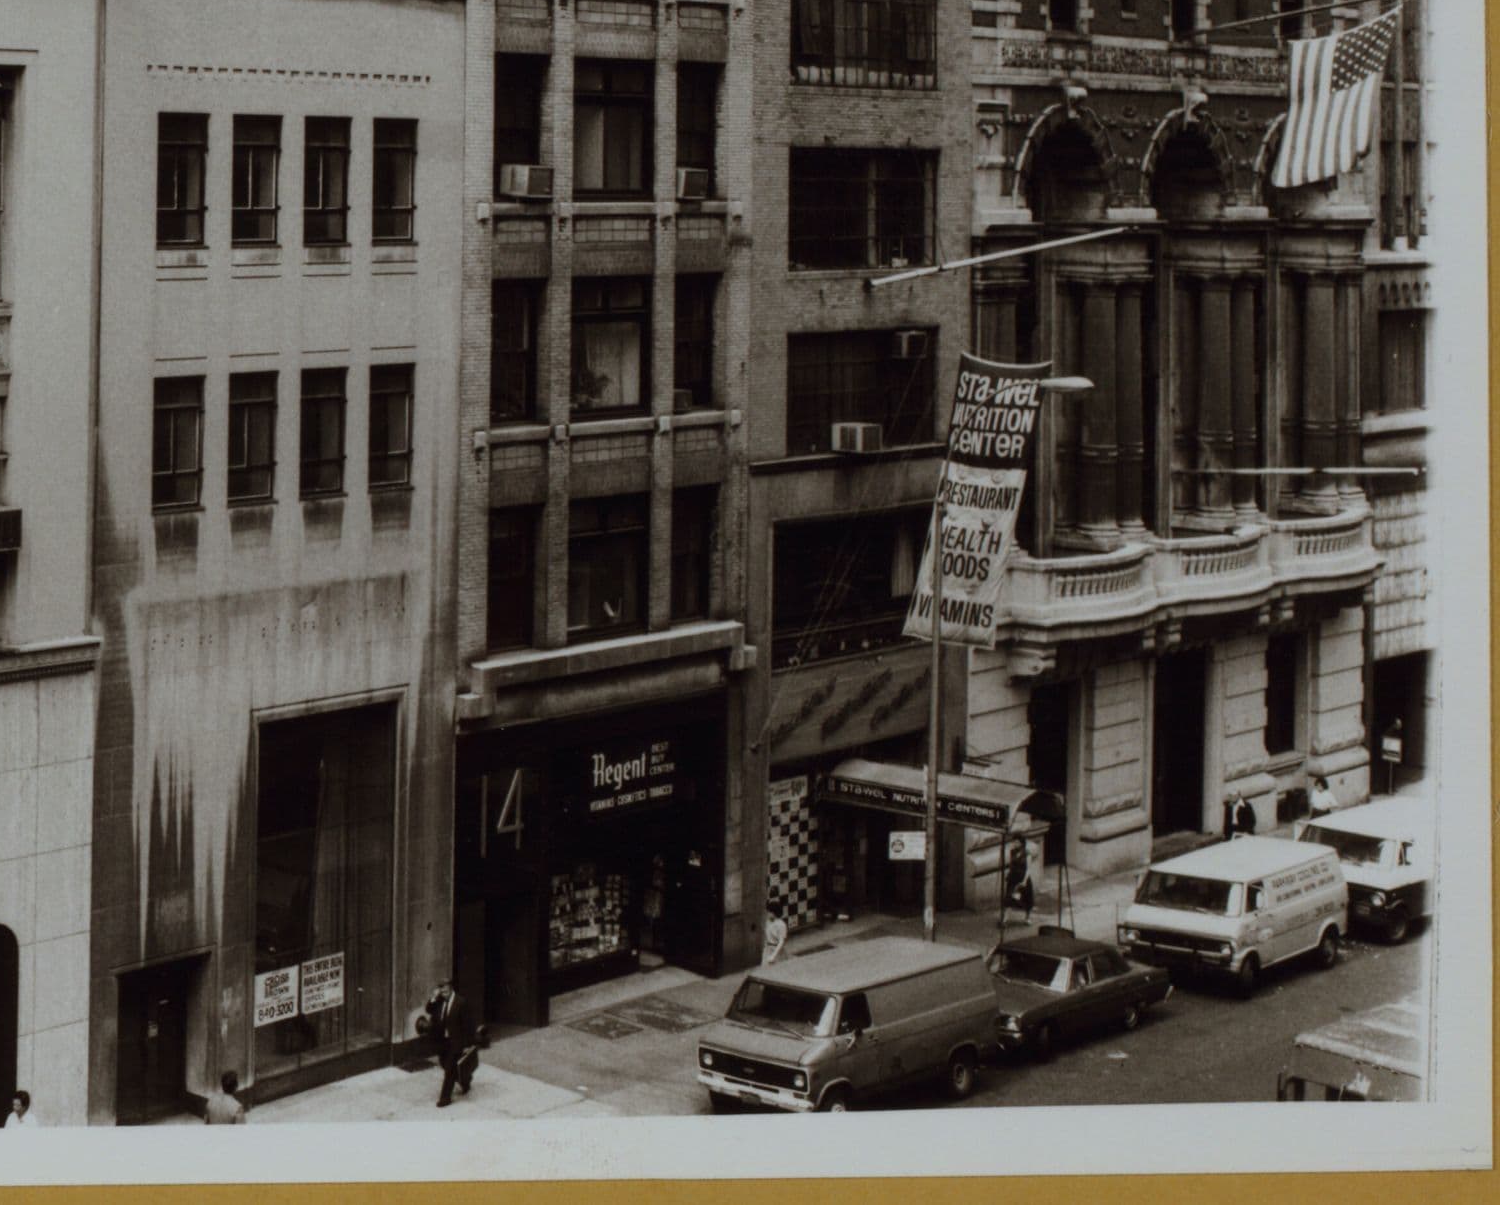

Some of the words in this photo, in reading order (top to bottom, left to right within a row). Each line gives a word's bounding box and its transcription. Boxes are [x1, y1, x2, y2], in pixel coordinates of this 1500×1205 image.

[952, 402, 1035, 434] NUTRITION
[941, 550, 990, 582] OODS
[918, 594, 994, 628] VIAMINS
[591, 751, 646, 790] Regent
[480, 767, 524, 858] 14
